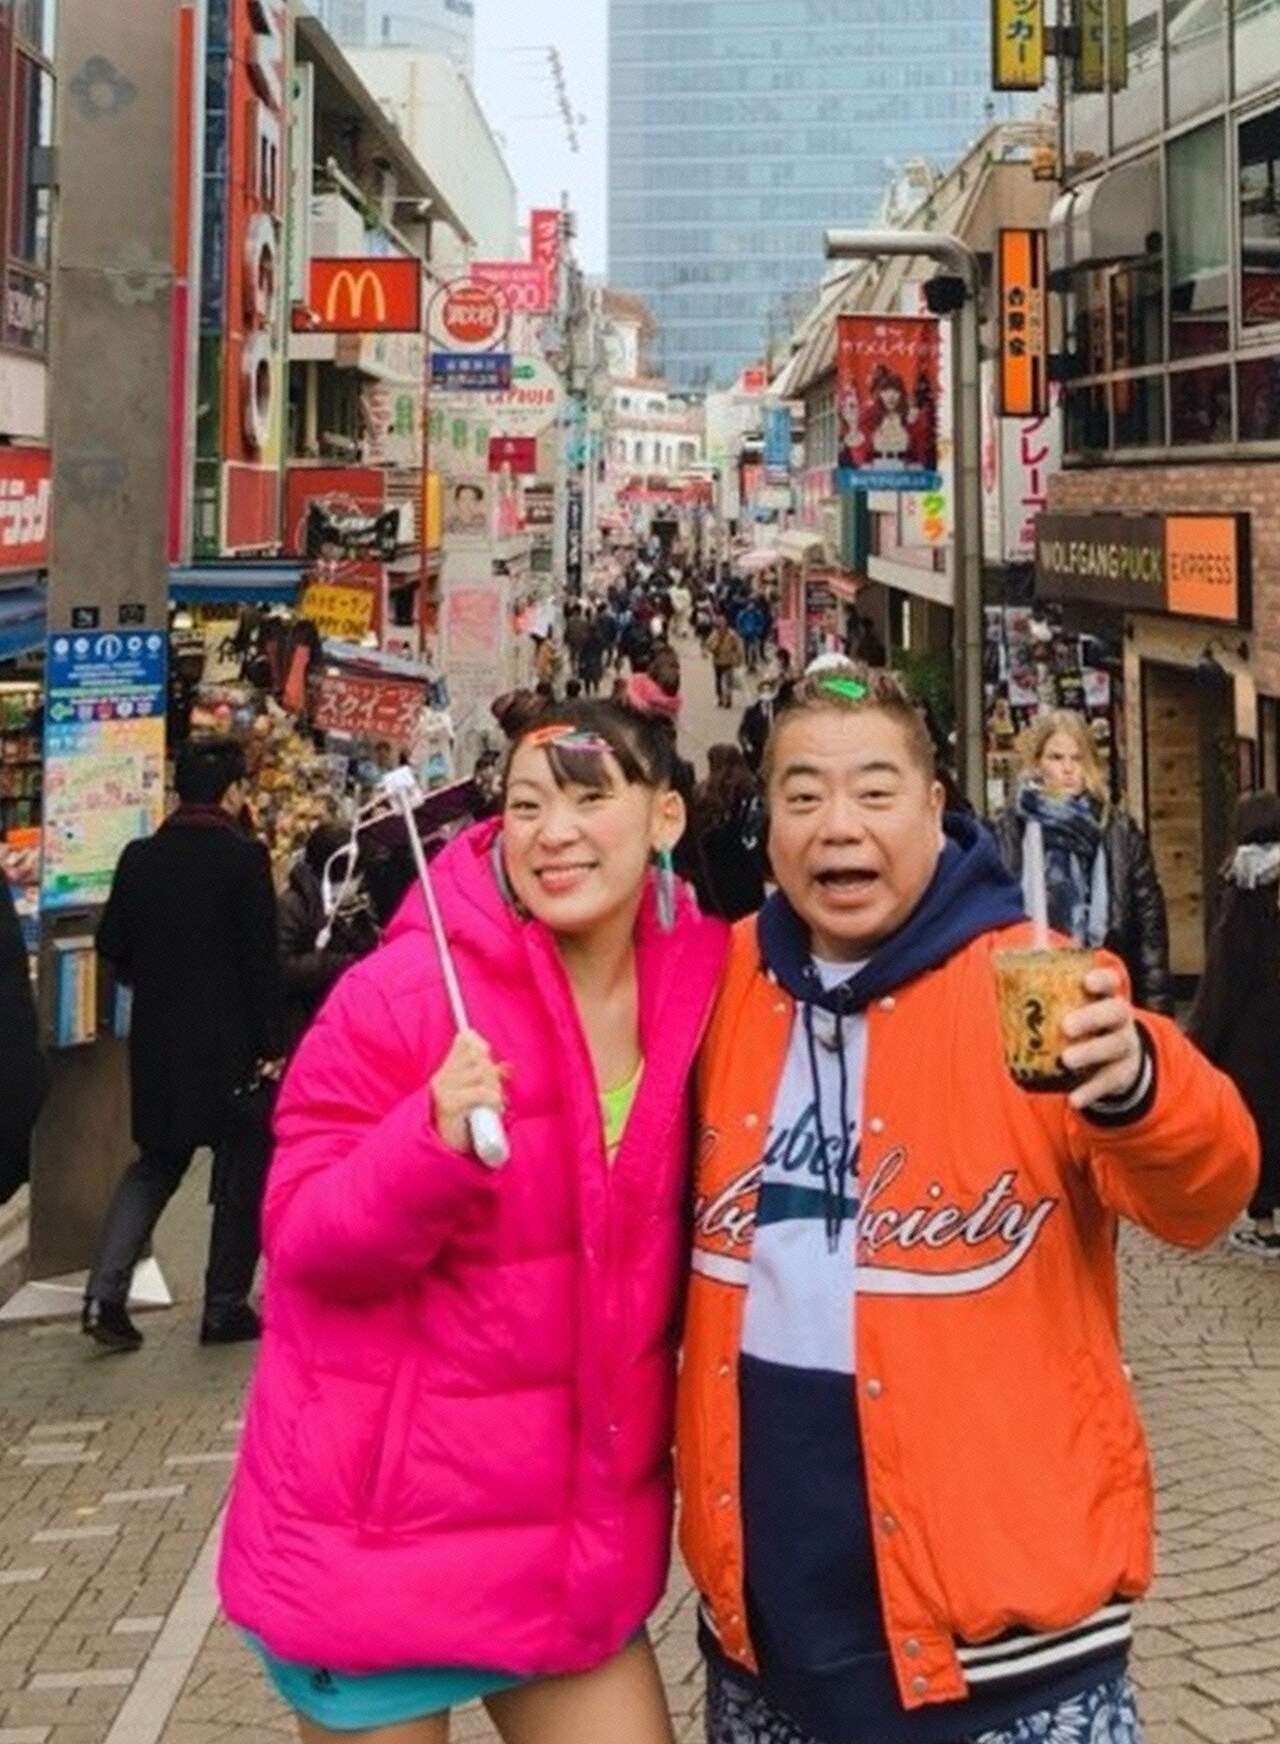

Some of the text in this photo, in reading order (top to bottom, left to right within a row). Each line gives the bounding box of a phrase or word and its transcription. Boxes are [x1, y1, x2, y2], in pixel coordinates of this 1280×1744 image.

[1040, 540, 1119, 580] WOLFGANG
[1119, 545, 1163, 585] PUCK
[1170, 552, 1232, 586] EXPRESS
